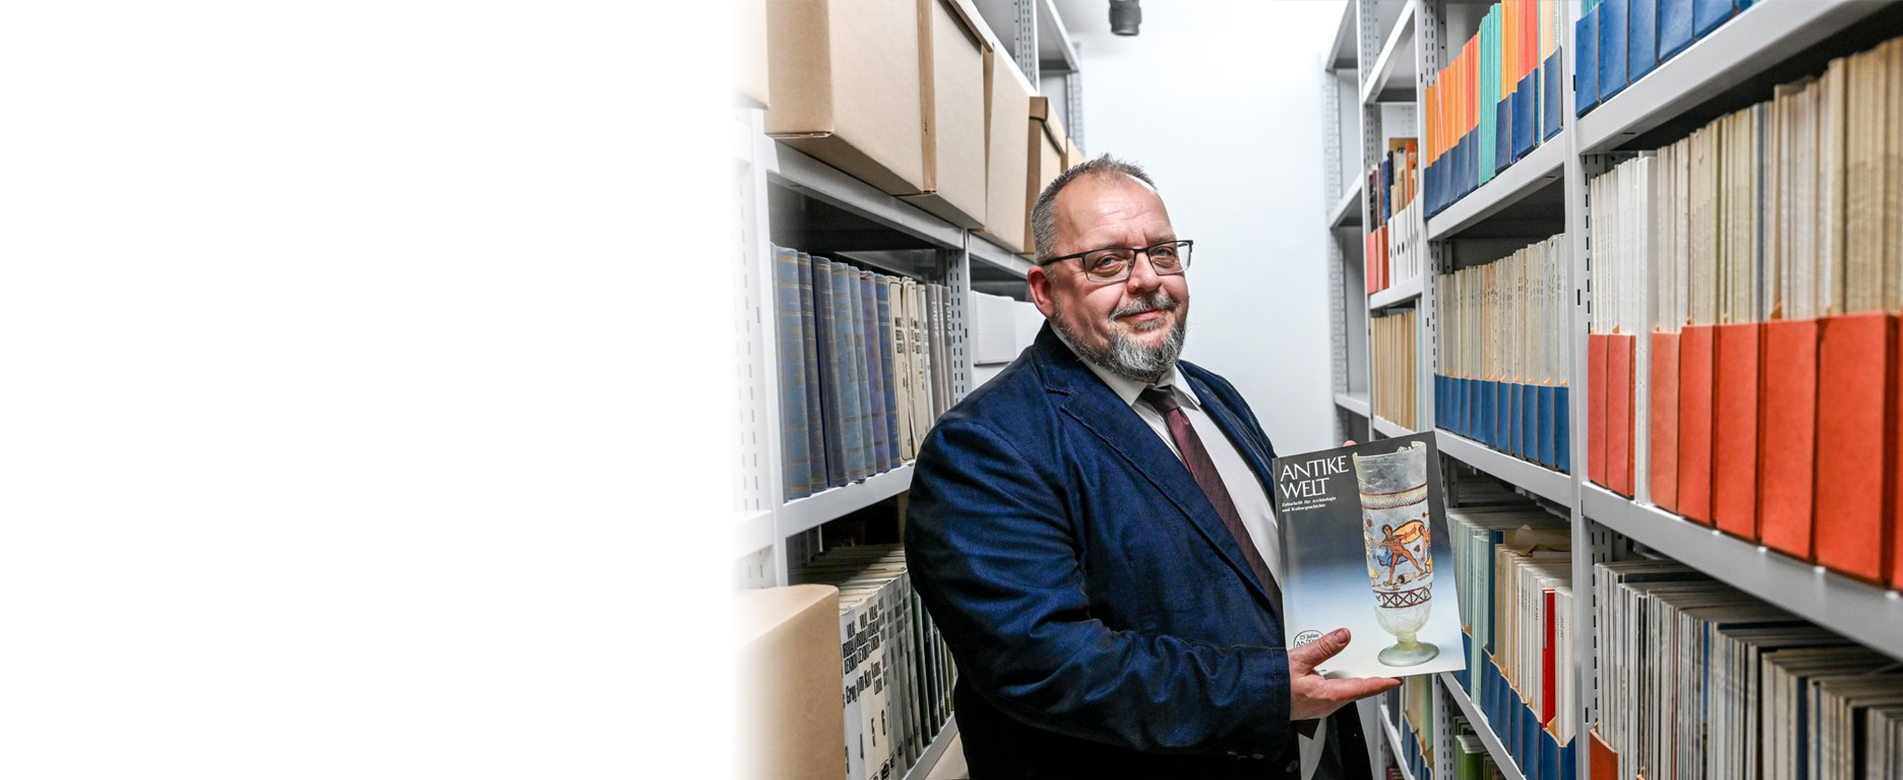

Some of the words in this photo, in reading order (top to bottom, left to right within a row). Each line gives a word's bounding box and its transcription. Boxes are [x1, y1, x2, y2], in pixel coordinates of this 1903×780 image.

[1280, 455, 1349, 482] ANTIKE
[1280, 477, 1330, 499] WELT
[1291, 503, 1326, 511] Kulturgeschichte
